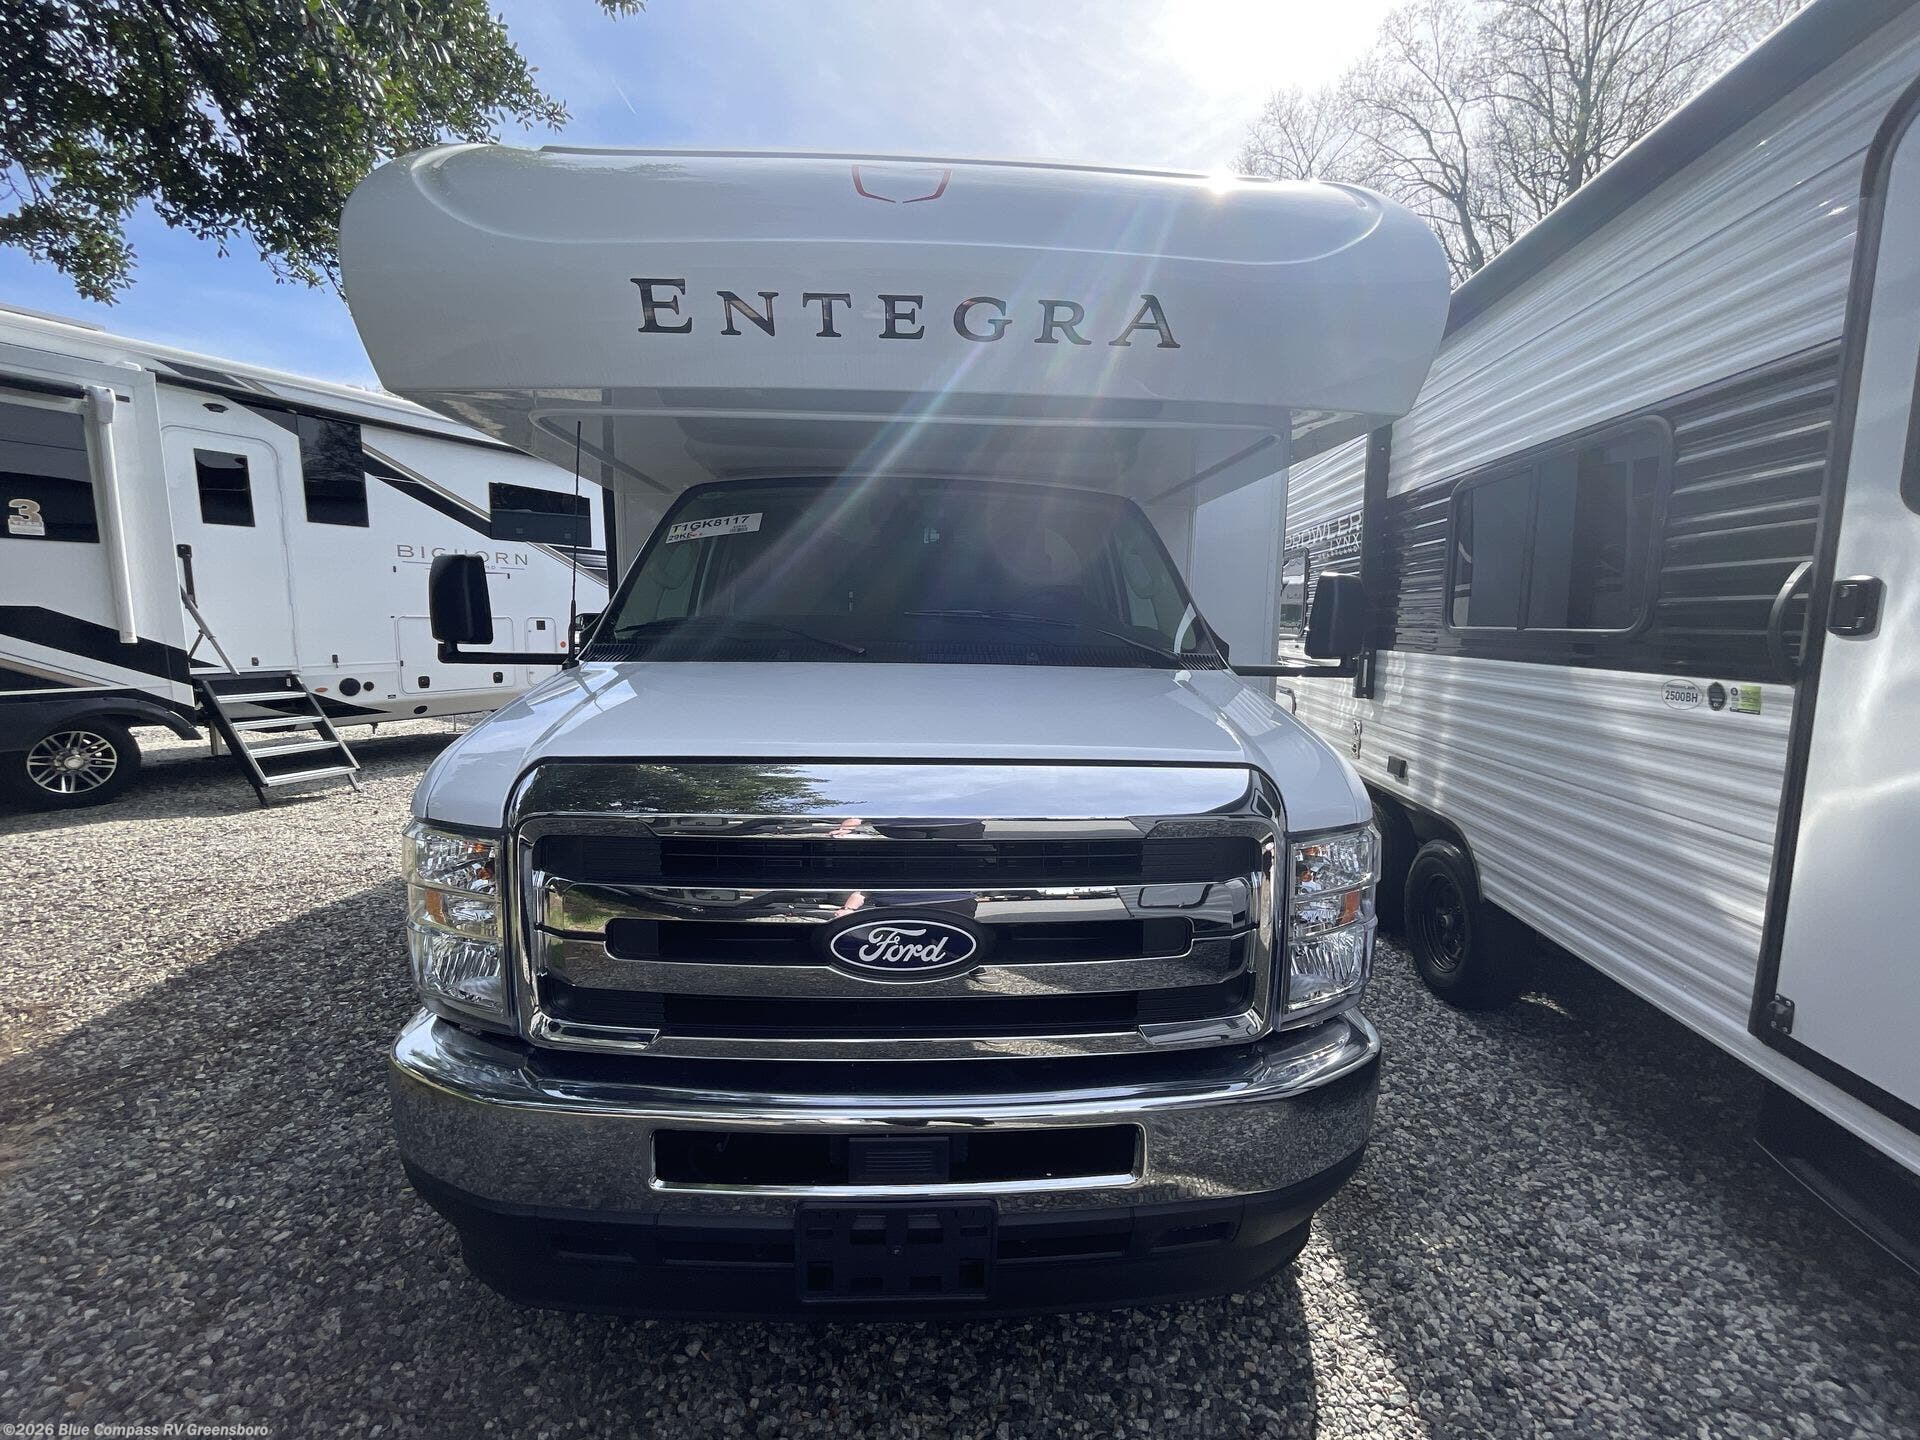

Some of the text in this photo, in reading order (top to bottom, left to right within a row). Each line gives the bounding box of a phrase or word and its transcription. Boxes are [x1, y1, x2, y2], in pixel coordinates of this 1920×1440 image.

[630, 277, 1181, 349] ENTEGRA
[671, 515, 750, 535] T1GK8117
[1664, 690, 1698, 703] 2500BH
[858, 926, 949, 962] Ford
